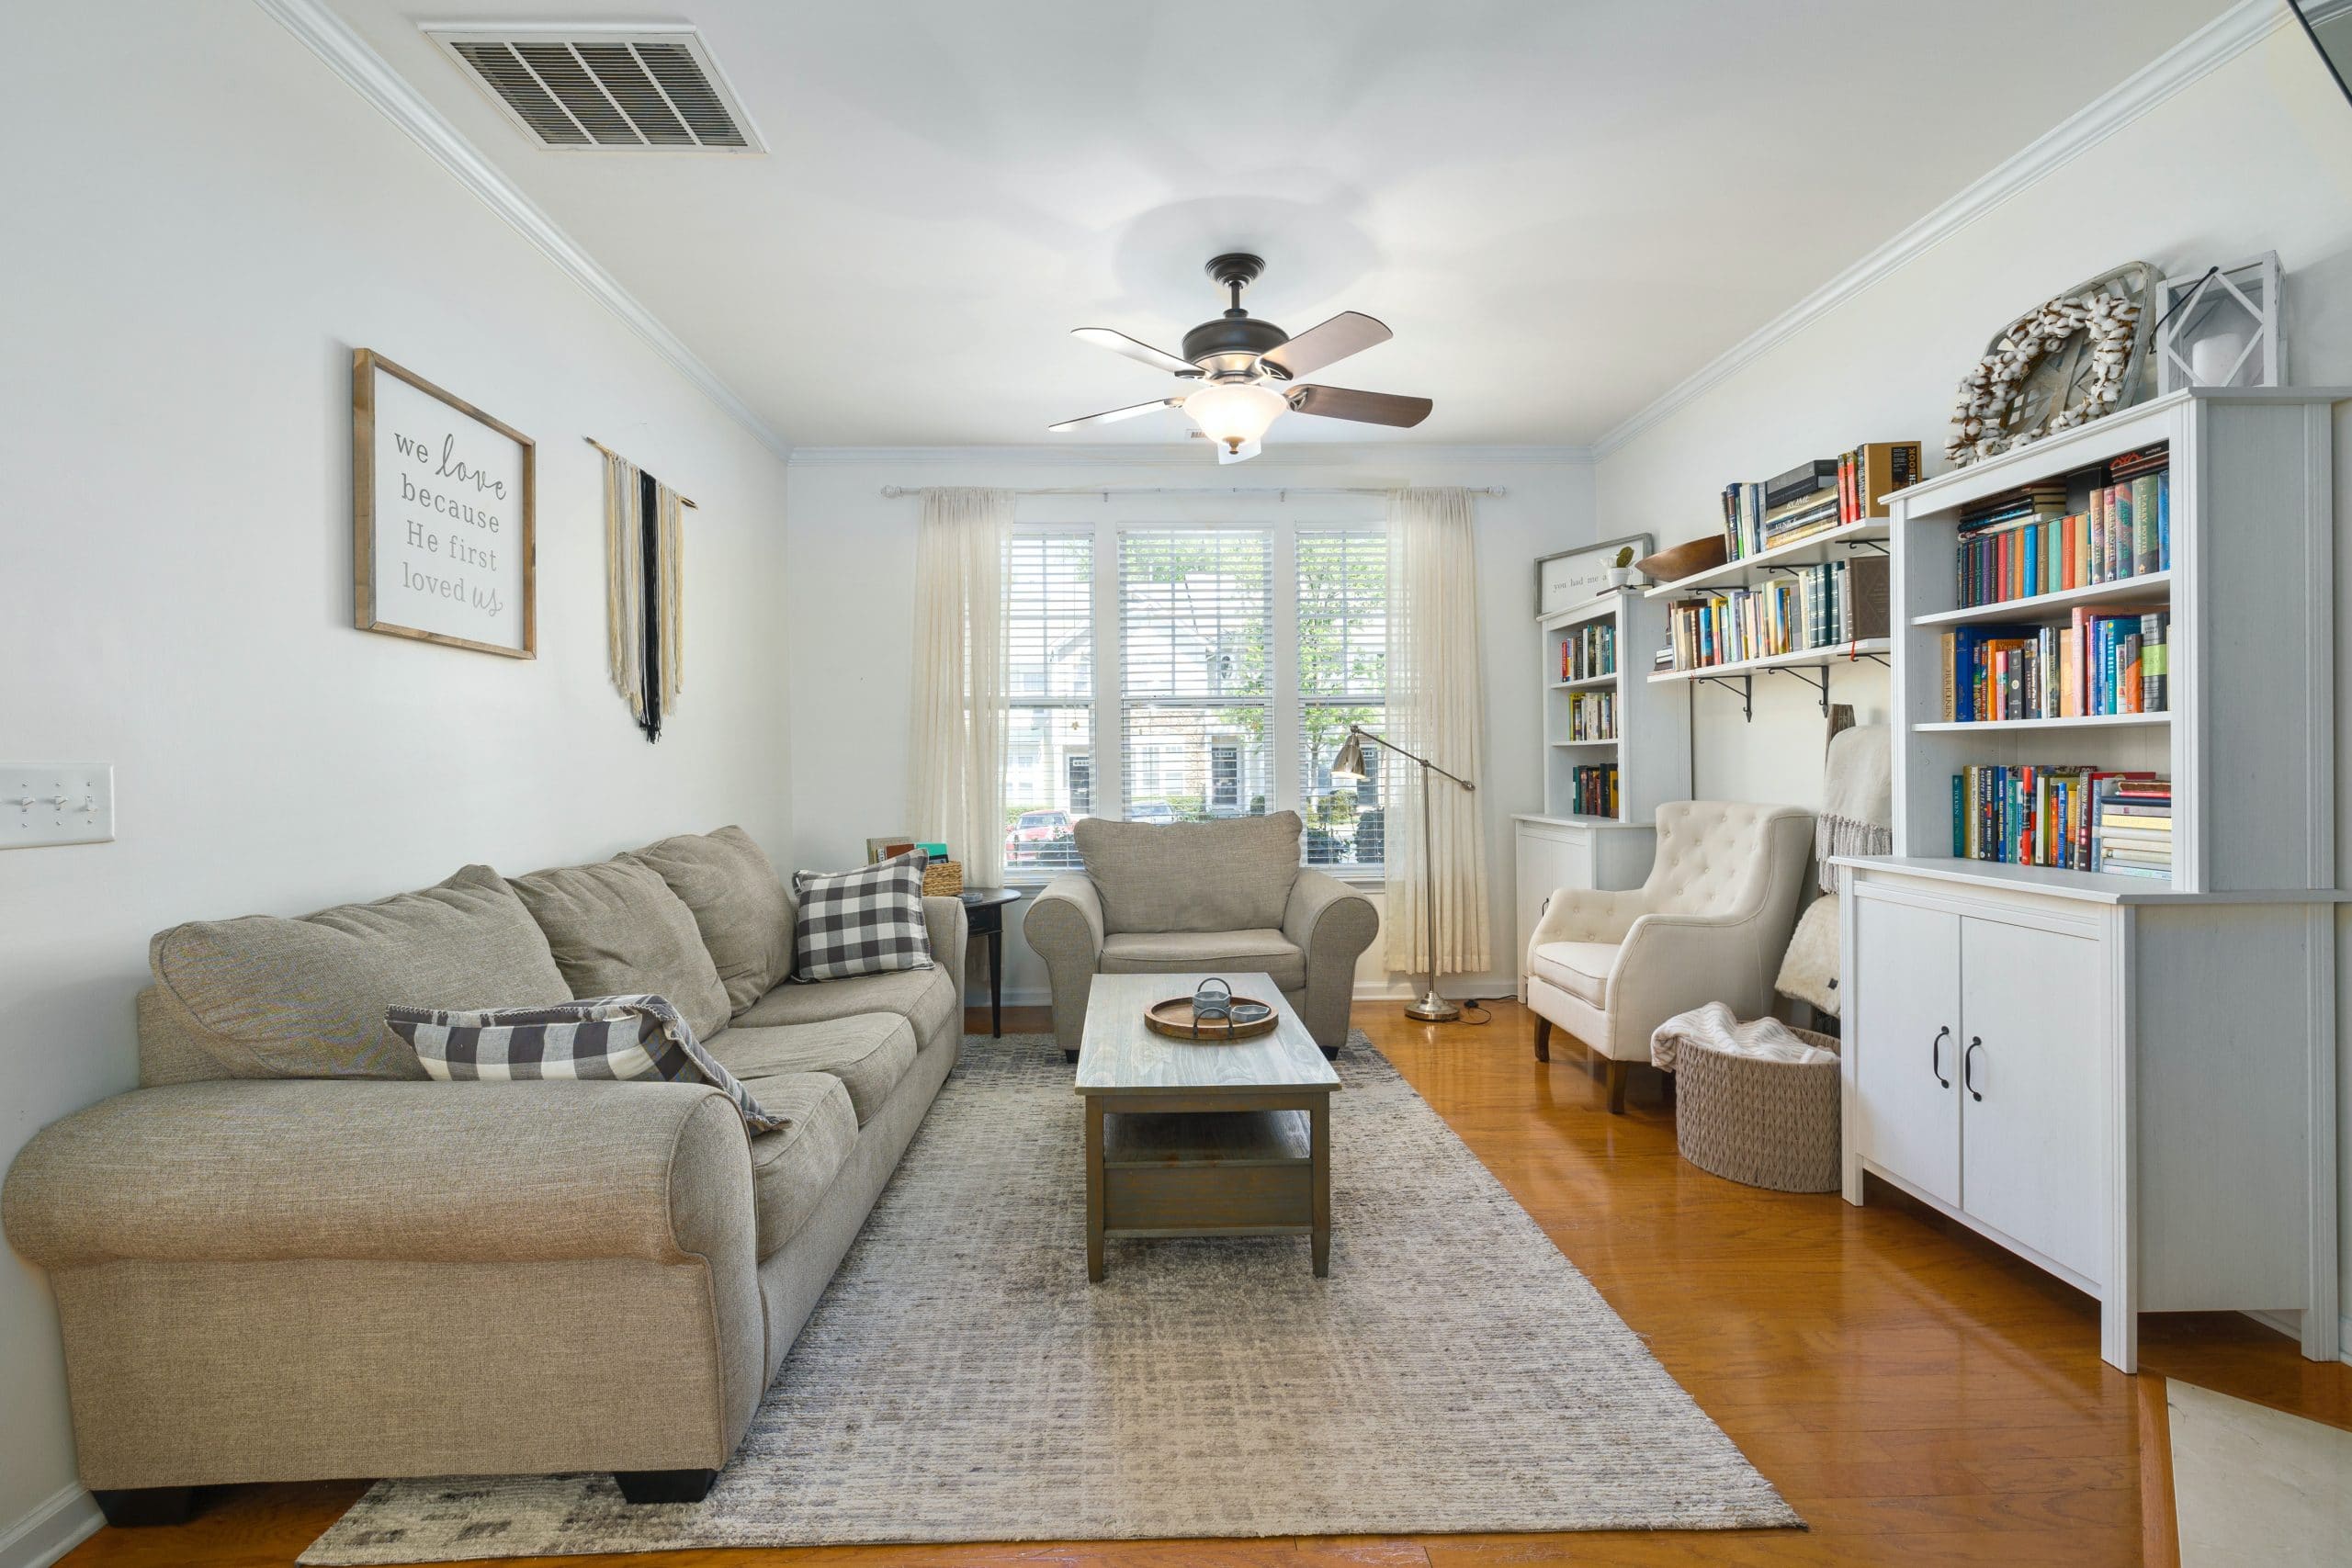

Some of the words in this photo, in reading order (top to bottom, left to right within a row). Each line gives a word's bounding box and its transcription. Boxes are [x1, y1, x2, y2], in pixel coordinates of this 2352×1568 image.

[394, 432, 428, 464] we
[435, 434, 506, 501] love
[401, 473, 499, 533] because
[407, 520, 437, 552] He
[449, 536, 497, 571] first
[402, 561, 466, 603] loved
[472, 587, 503, 617] us
[1553, 582, 1566, 592] you
[1570, 577, 1583, 587] had
